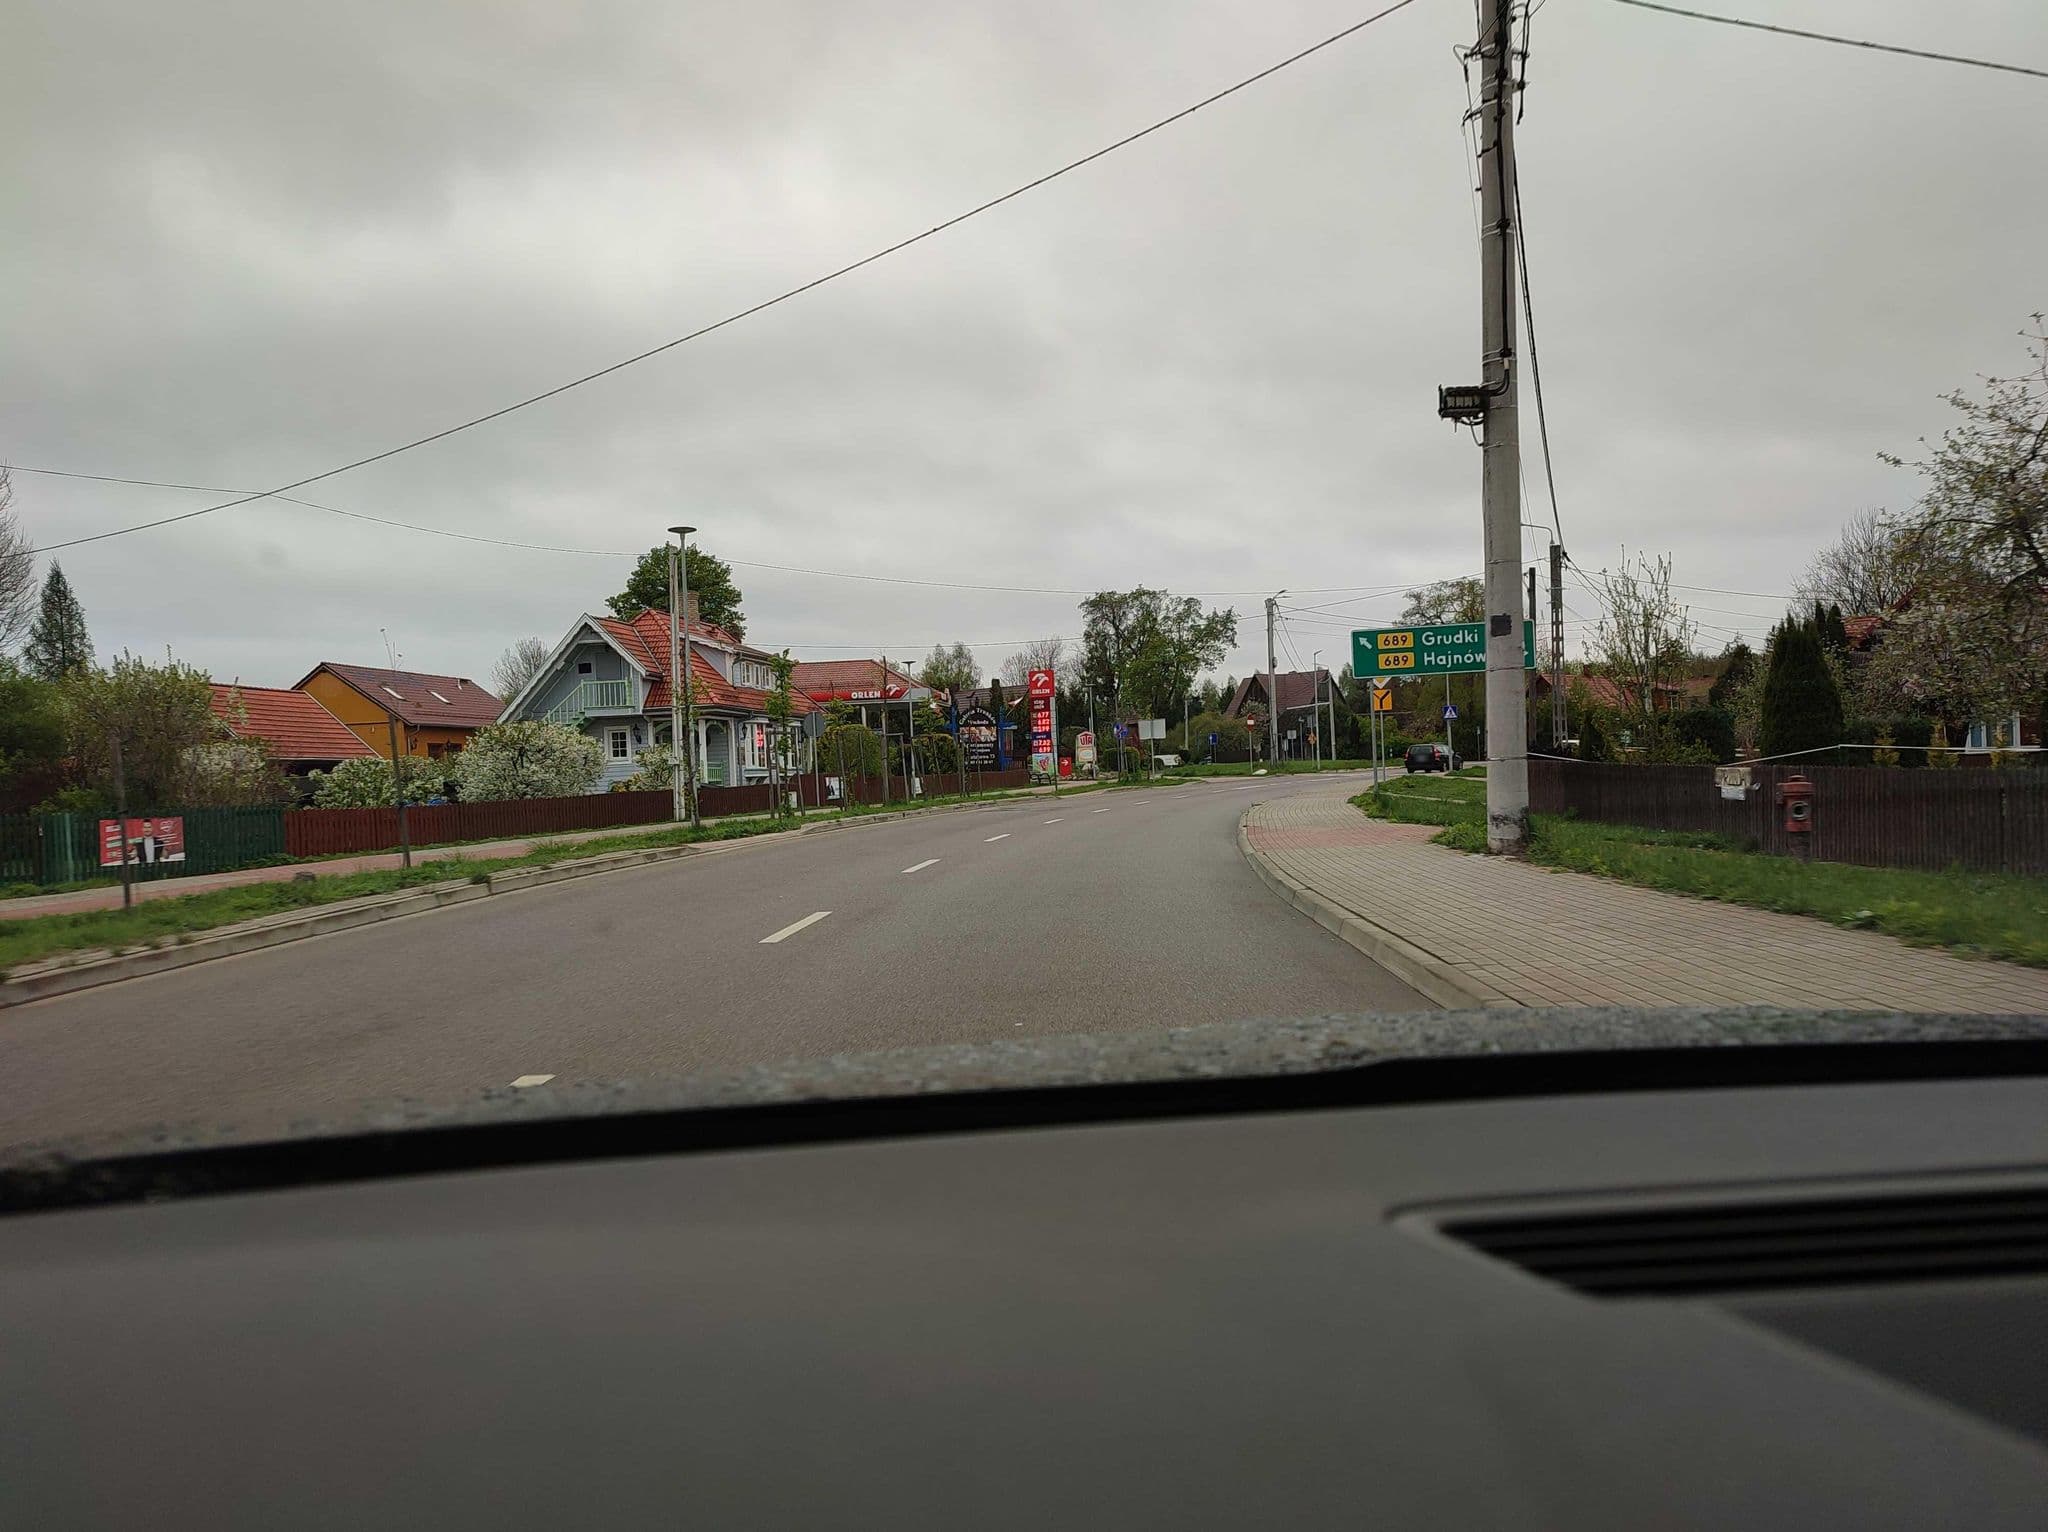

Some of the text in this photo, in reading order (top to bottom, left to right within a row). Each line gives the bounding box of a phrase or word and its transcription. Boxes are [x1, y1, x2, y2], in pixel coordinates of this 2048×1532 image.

[1383, 630, 1478, 647] 689 Grudki
[1384, 650, 1485, 667] 689 Hajnów
[851, 690, 881, 699] ORLEN
